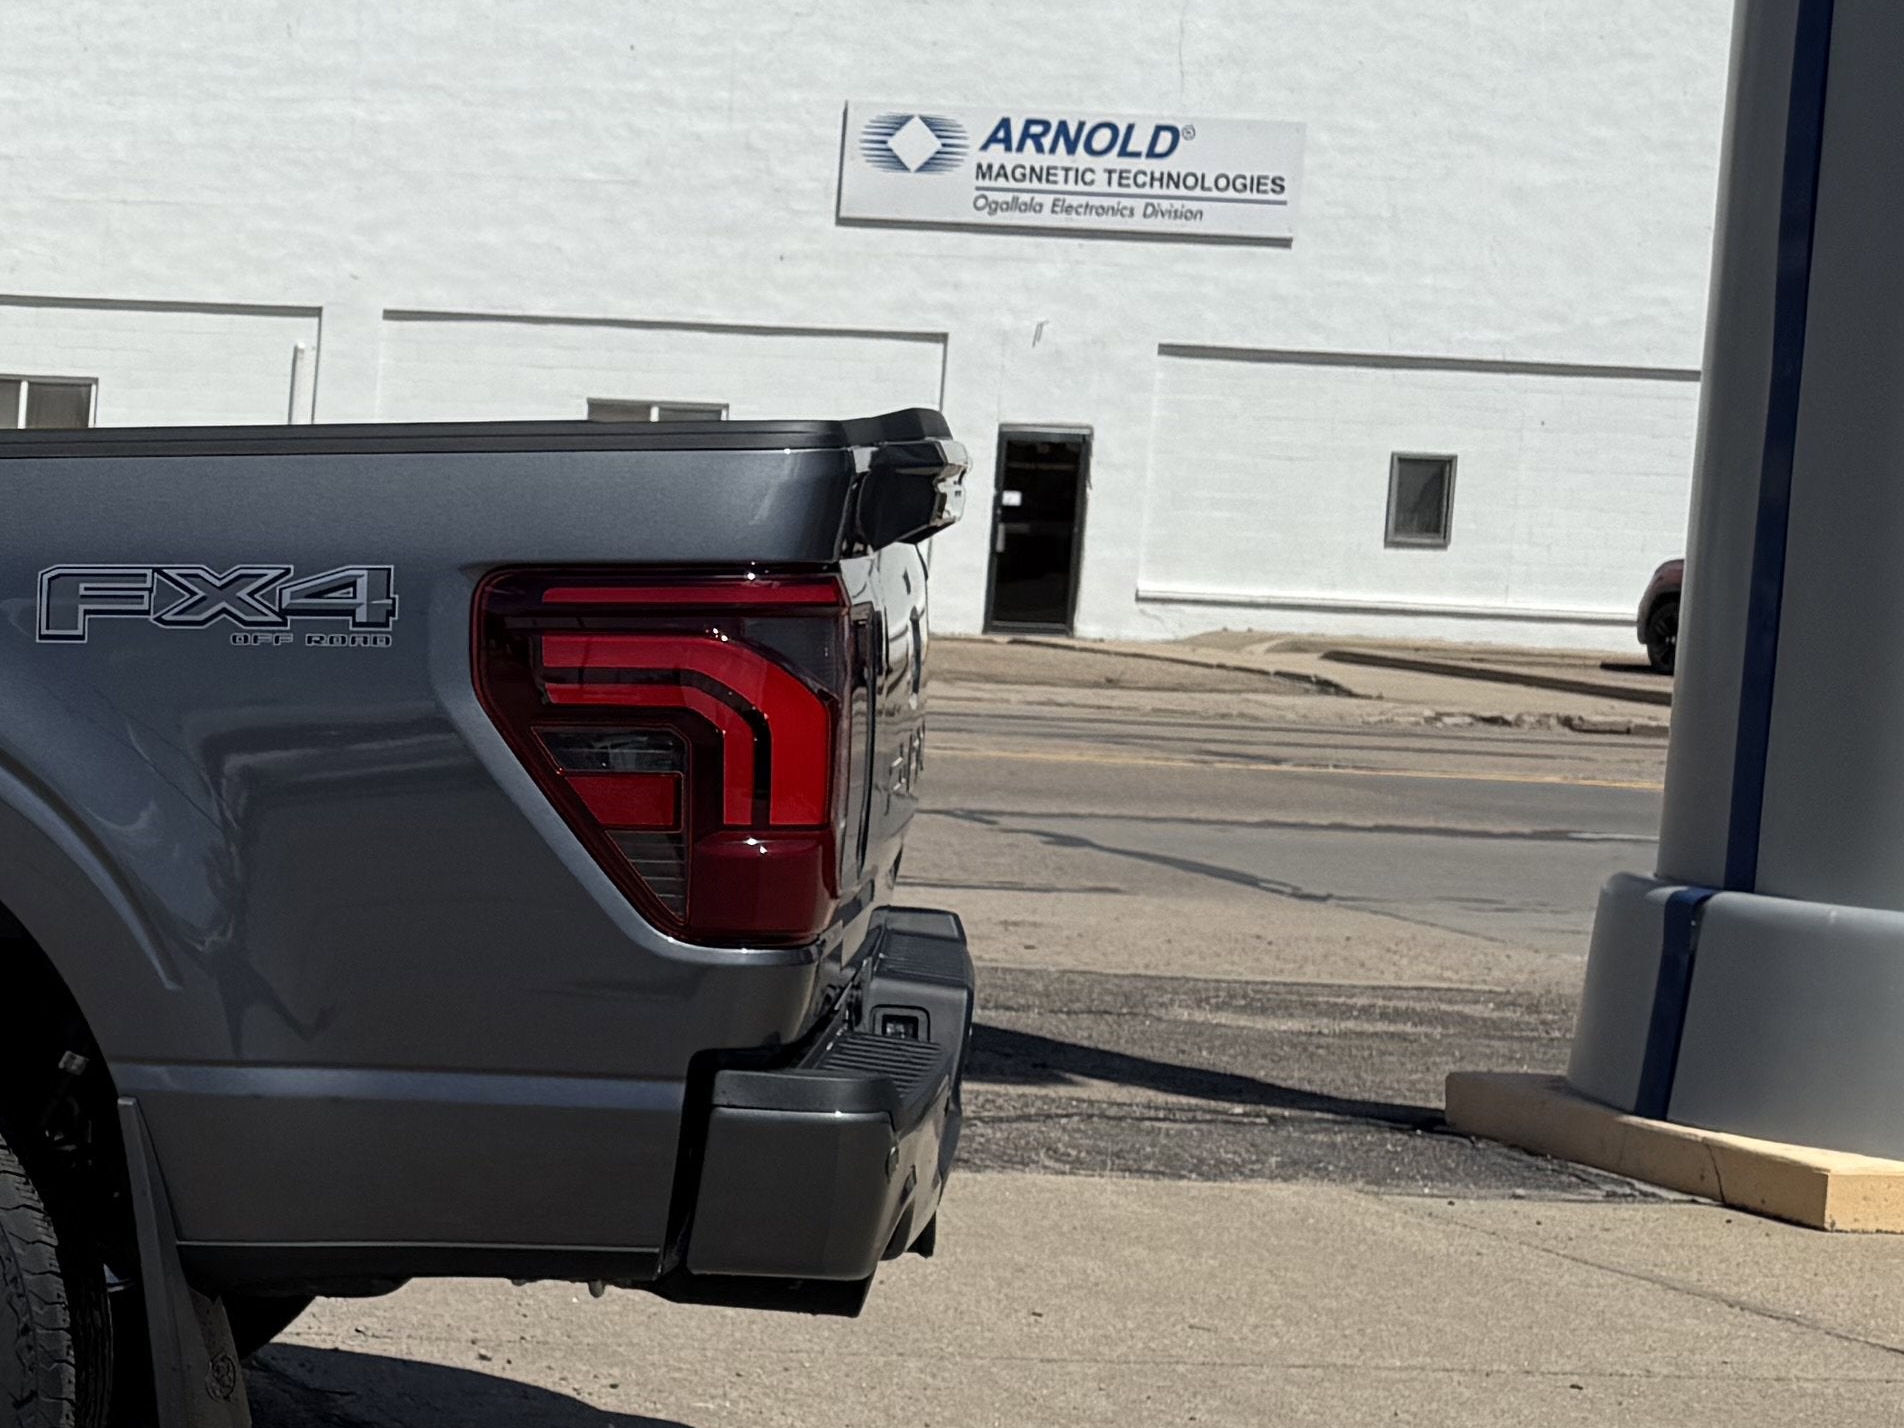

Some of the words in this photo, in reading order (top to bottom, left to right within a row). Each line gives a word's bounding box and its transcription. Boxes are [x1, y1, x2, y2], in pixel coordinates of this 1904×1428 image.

[975, 162, 1096, 187] MAGNETIC
[1106, 169, 1286, 195] TECHNOLOGIES
[972, 194, 1044, 217] Ogallala
[1050, 198, 1136, 220] Electronics
[1142, 204, 1204, 222] Division
[36, 565, 398, 643] FX4
[230, 632, 293, 647] OFF
[305, 633, 392, 648] ROAD
